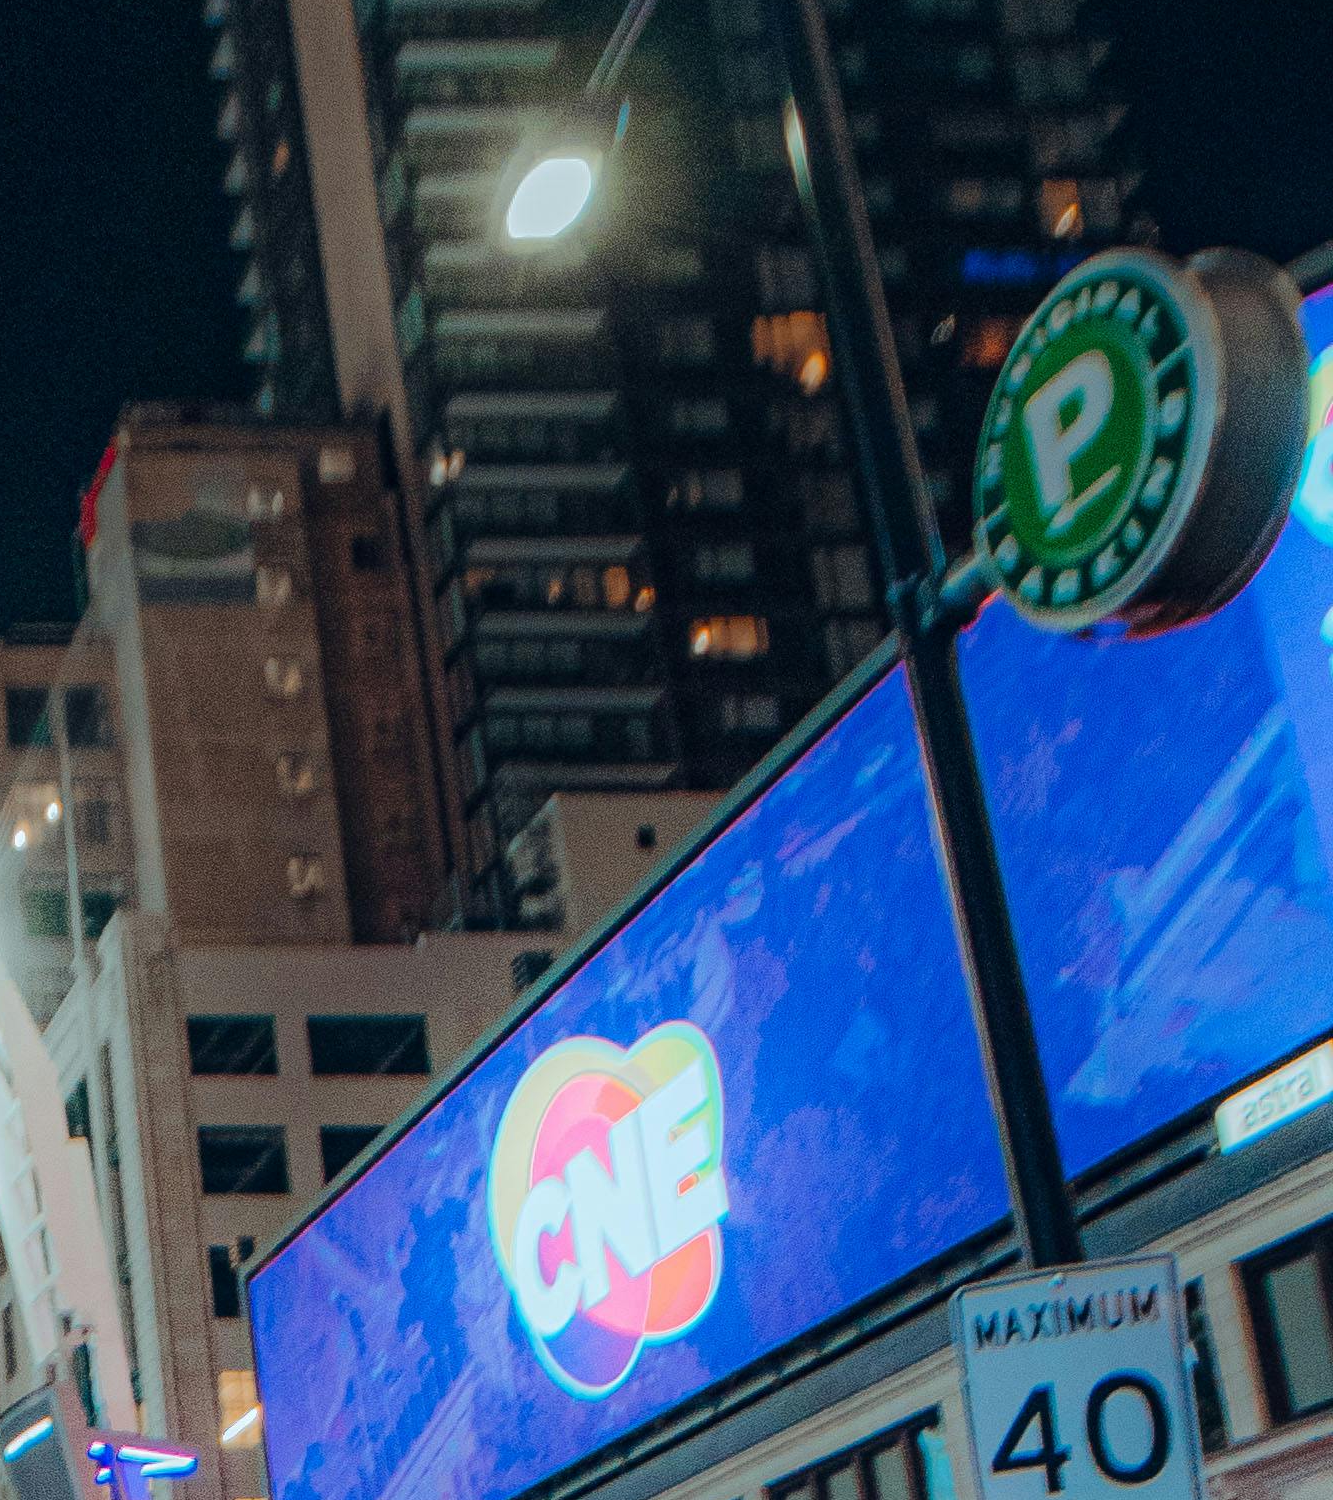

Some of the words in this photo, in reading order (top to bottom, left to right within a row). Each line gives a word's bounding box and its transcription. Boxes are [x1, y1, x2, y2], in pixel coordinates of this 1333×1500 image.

[1022, 348, 1115, 521] P
[510, 1062, 729, 1340] CNE
[974, 1283, 1161, 1350] MAXIMUM
[990, 1367, 1172, 1496] 40
